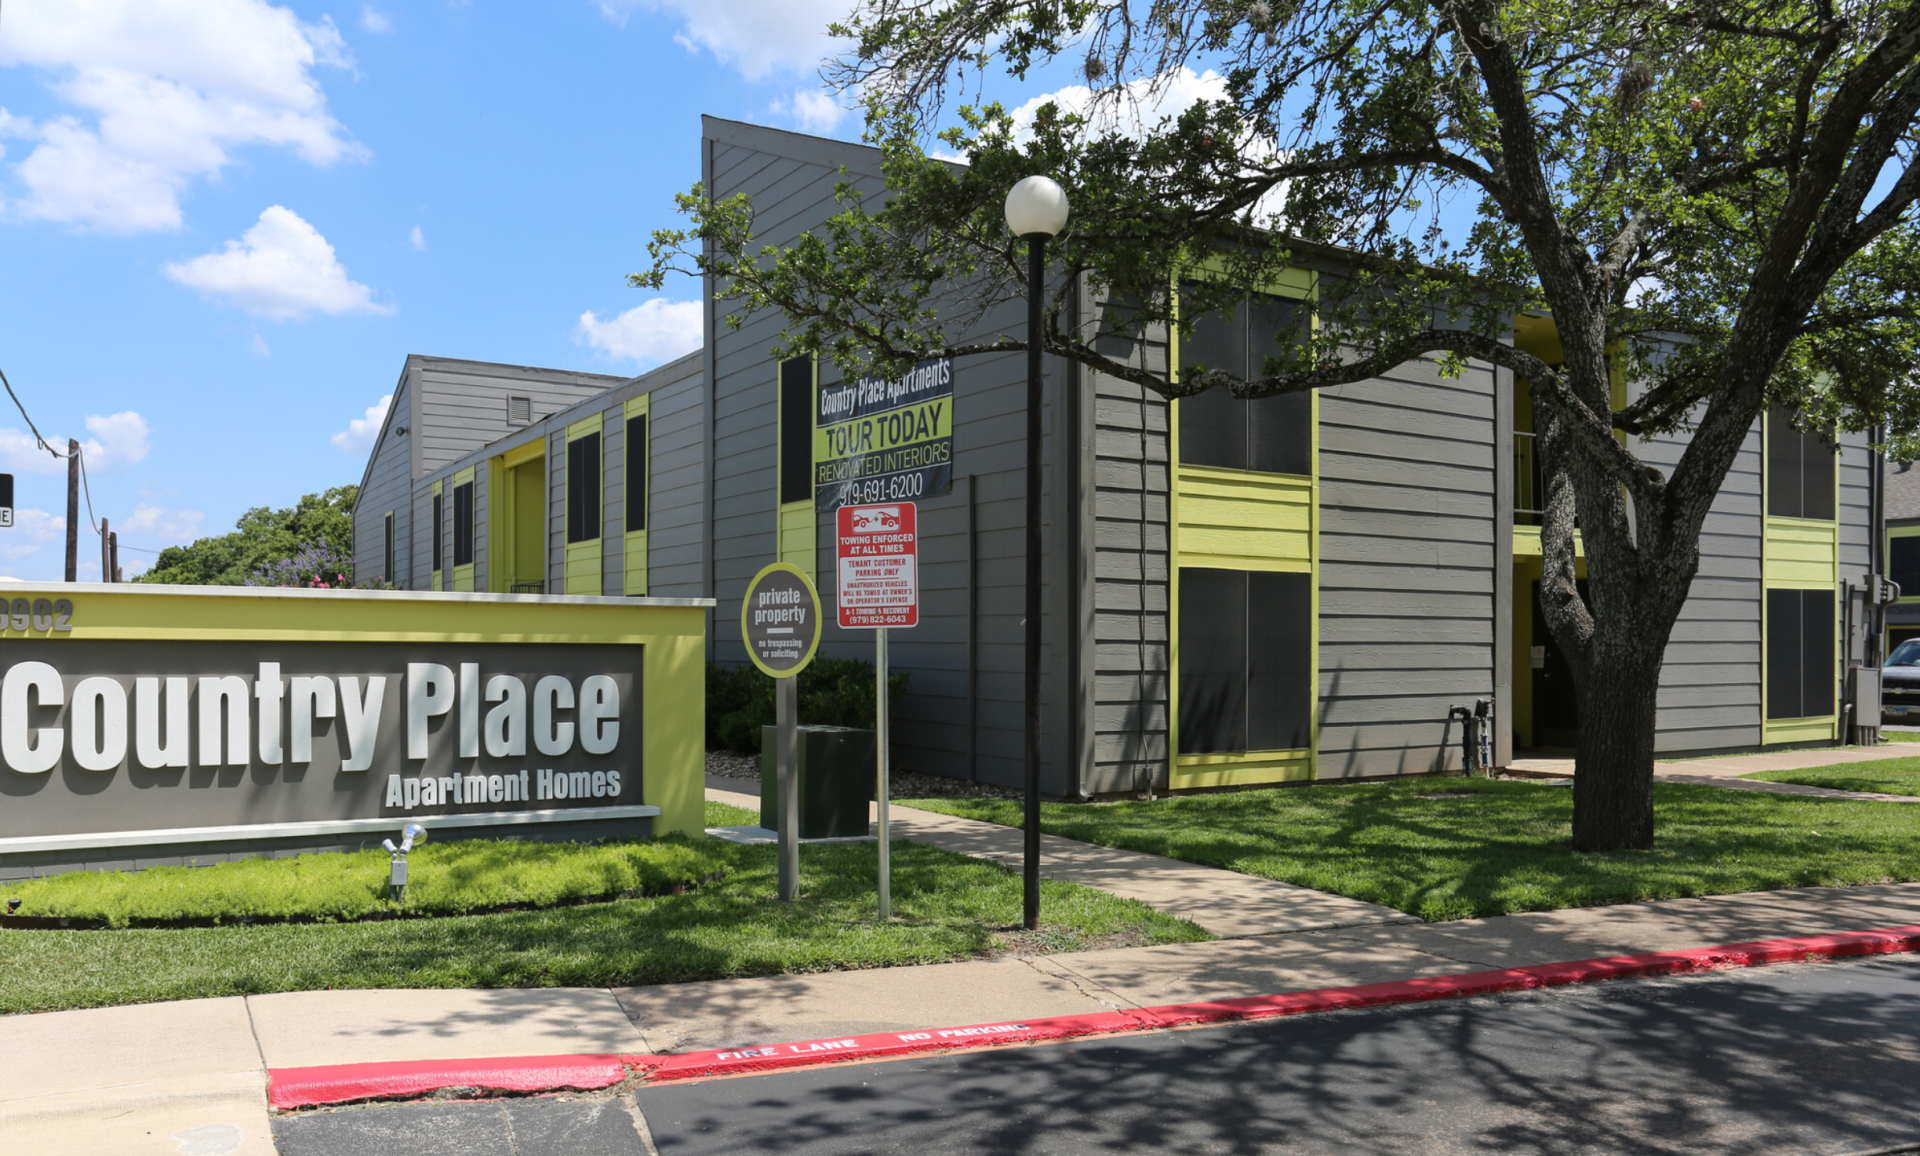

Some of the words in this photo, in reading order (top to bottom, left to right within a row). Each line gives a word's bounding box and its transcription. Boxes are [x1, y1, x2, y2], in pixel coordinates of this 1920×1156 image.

[821, 386, 857, 416] Country
[858, 377, 885, 406] Place
[826, 420, 873, 458] TOUR
[877, 402, 943, 448] TODAY
[819, 455, 882, 483] RENOVATED
[884, 441, 950, 472] INTERIORS
[839, 472, 923, 506] 979-691-6200
[0, 510, 9, 523] E
[840, 535, 871, 545] TOWING
[872, 533, 914, 544] ENFORCED
[850, 546, 861, 554] AT
[862, 545, 877, 554] ALL
[879, 544, 904, 553] TIMES
[848, 559, 871, 568] TENANT
[874, 558, 906, 567] CUSTOMER
[855, 568, 882, 577] PARKING
[884, 568, 900, 576] ONLY
[847, 581, 883, 589] UNAUTHORIZED
[885, 580, 908, 588] VEHICLES
[758, 587, 801, 608] private
[754, 605, 806, 626] property
[856, 607, 876, 615] TOWING
[883, 606, 911, 614] RECOVERY
[758, 640, 766, 648] no
[767, 638, 803, 649] trespassing
[762, 650, 769, 658] or
[770, 648, 799, 659] soliciting
[1, 661, 387, 774] Country
[407, 662, 621, 760] Place
[385, 769, 530, 810] Apartment
[537, 769, 622, 800] Homes
[716, 1047, 780, 1061] FIRE
[789, 1039, 860, 1053] LANE
[897, 1032, 932, 1043] NO
[937, 1023, 1031, 1039] PARKING
